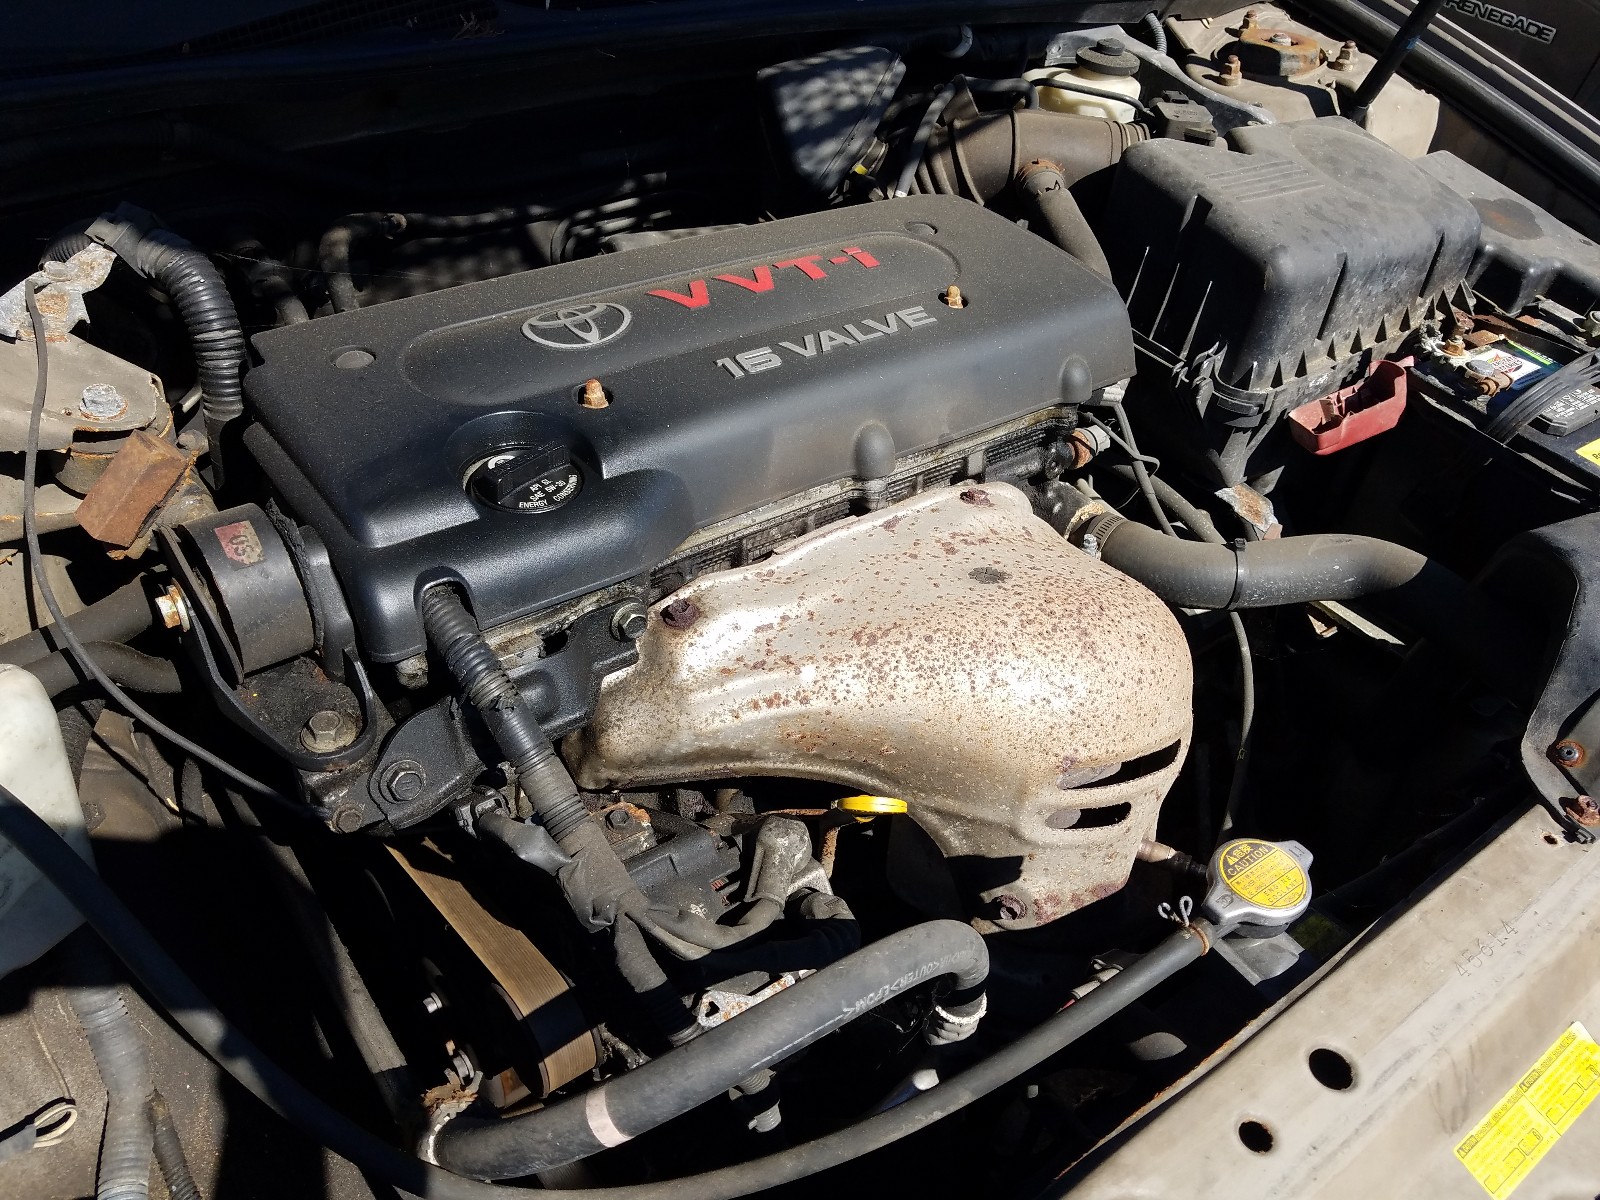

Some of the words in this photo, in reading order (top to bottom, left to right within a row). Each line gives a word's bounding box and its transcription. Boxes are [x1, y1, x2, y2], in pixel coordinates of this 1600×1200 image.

[1444, 0, 1556, 44] RENEGADE
[714, 345, 783, 380] 16
[777, 305, 938, 359] VALVE
[519, 500, 548, 508] ENERGY
[530, 490, 546, 501] SAE
[1228, 846, 1269, 876] CAUTION
